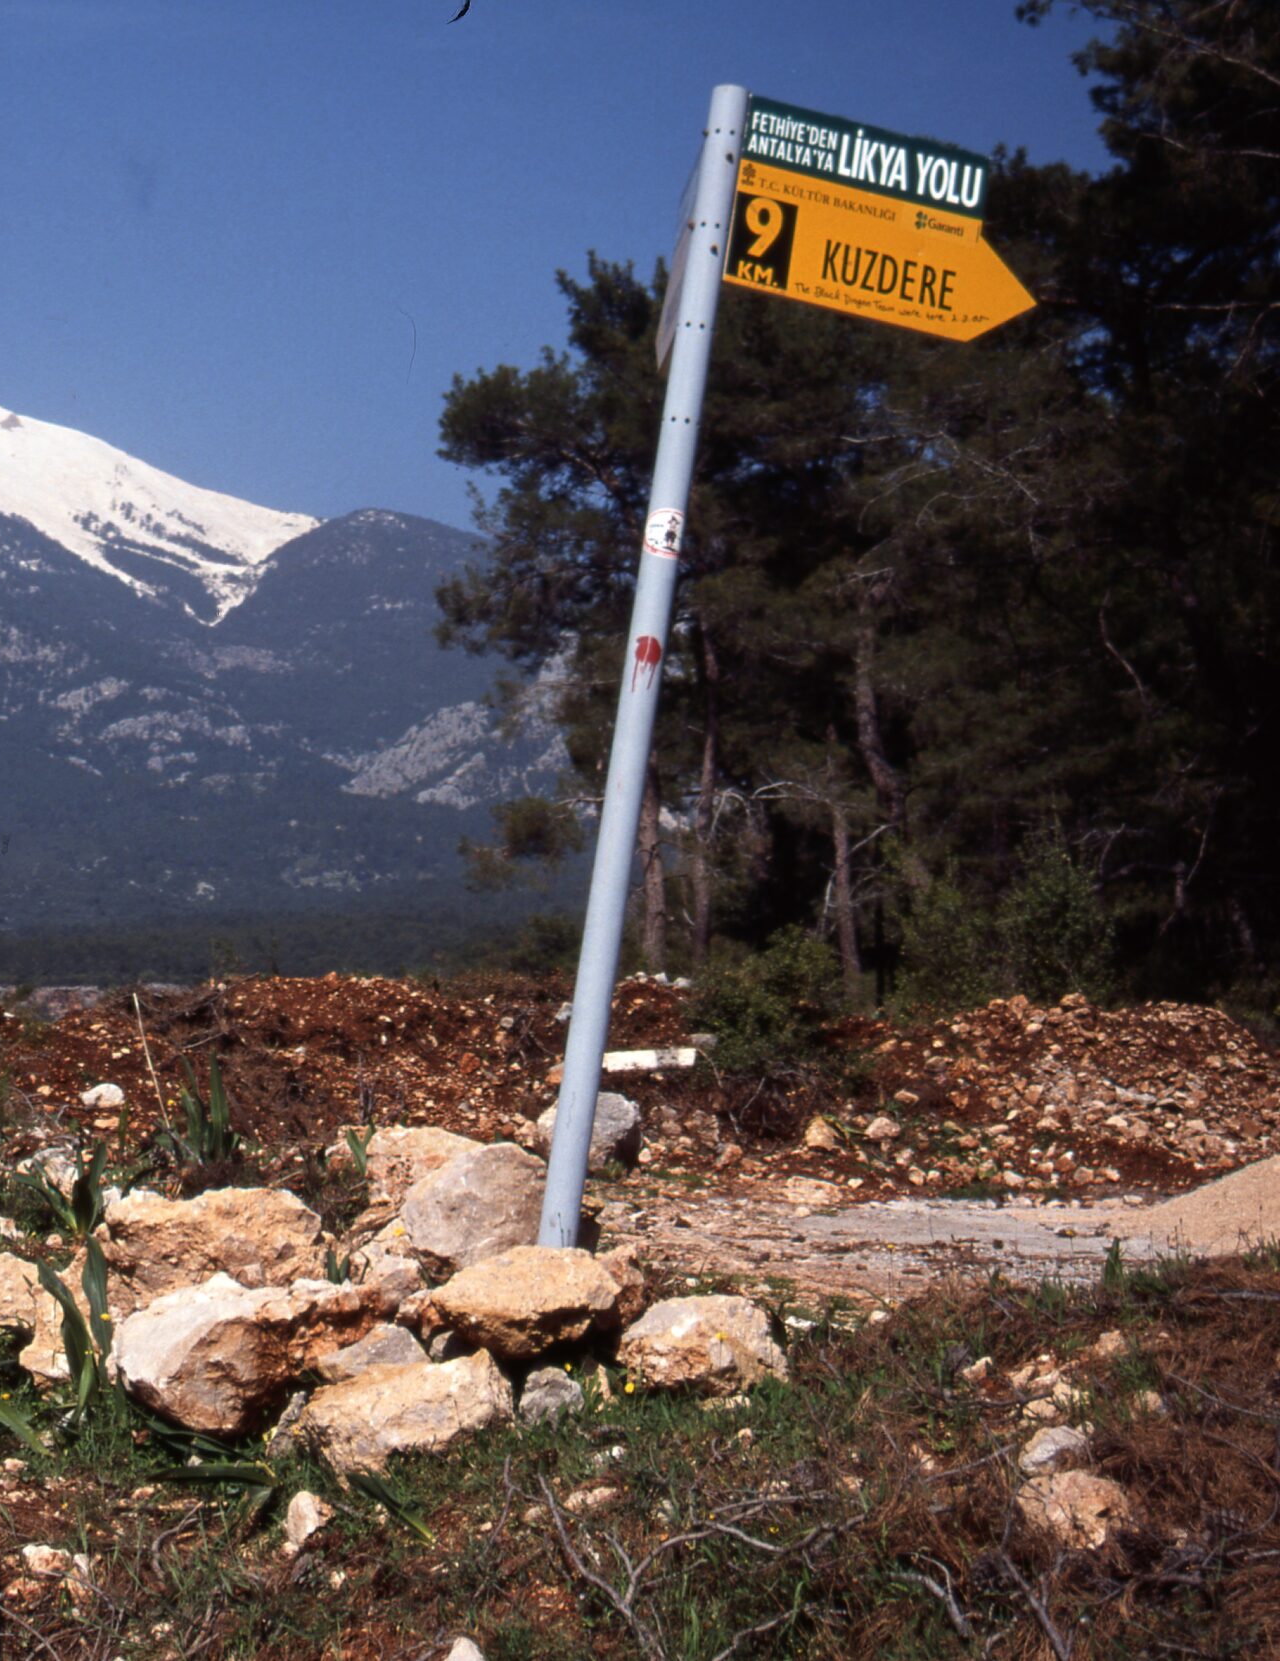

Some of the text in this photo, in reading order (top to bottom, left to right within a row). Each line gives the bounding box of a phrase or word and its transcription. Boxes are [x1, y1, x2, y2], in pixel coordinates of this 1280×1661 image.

[751, 111, 839, 151] FETHİYE'DEN
[747, 132, 834, 173] ANTALYA'YA
[838, 128, 983, 208] LİKYA YOLU
[783, 183, 830, 206] KÜLTÜR
[833, 196, 897, 222] BAKANLIĞI
[745, 197, 783, 258] 9
[927, 217, 964, 237] Garanti
[736, 260, 779, 288] KM.
[821, 239, 957, 311] KUZDERE
